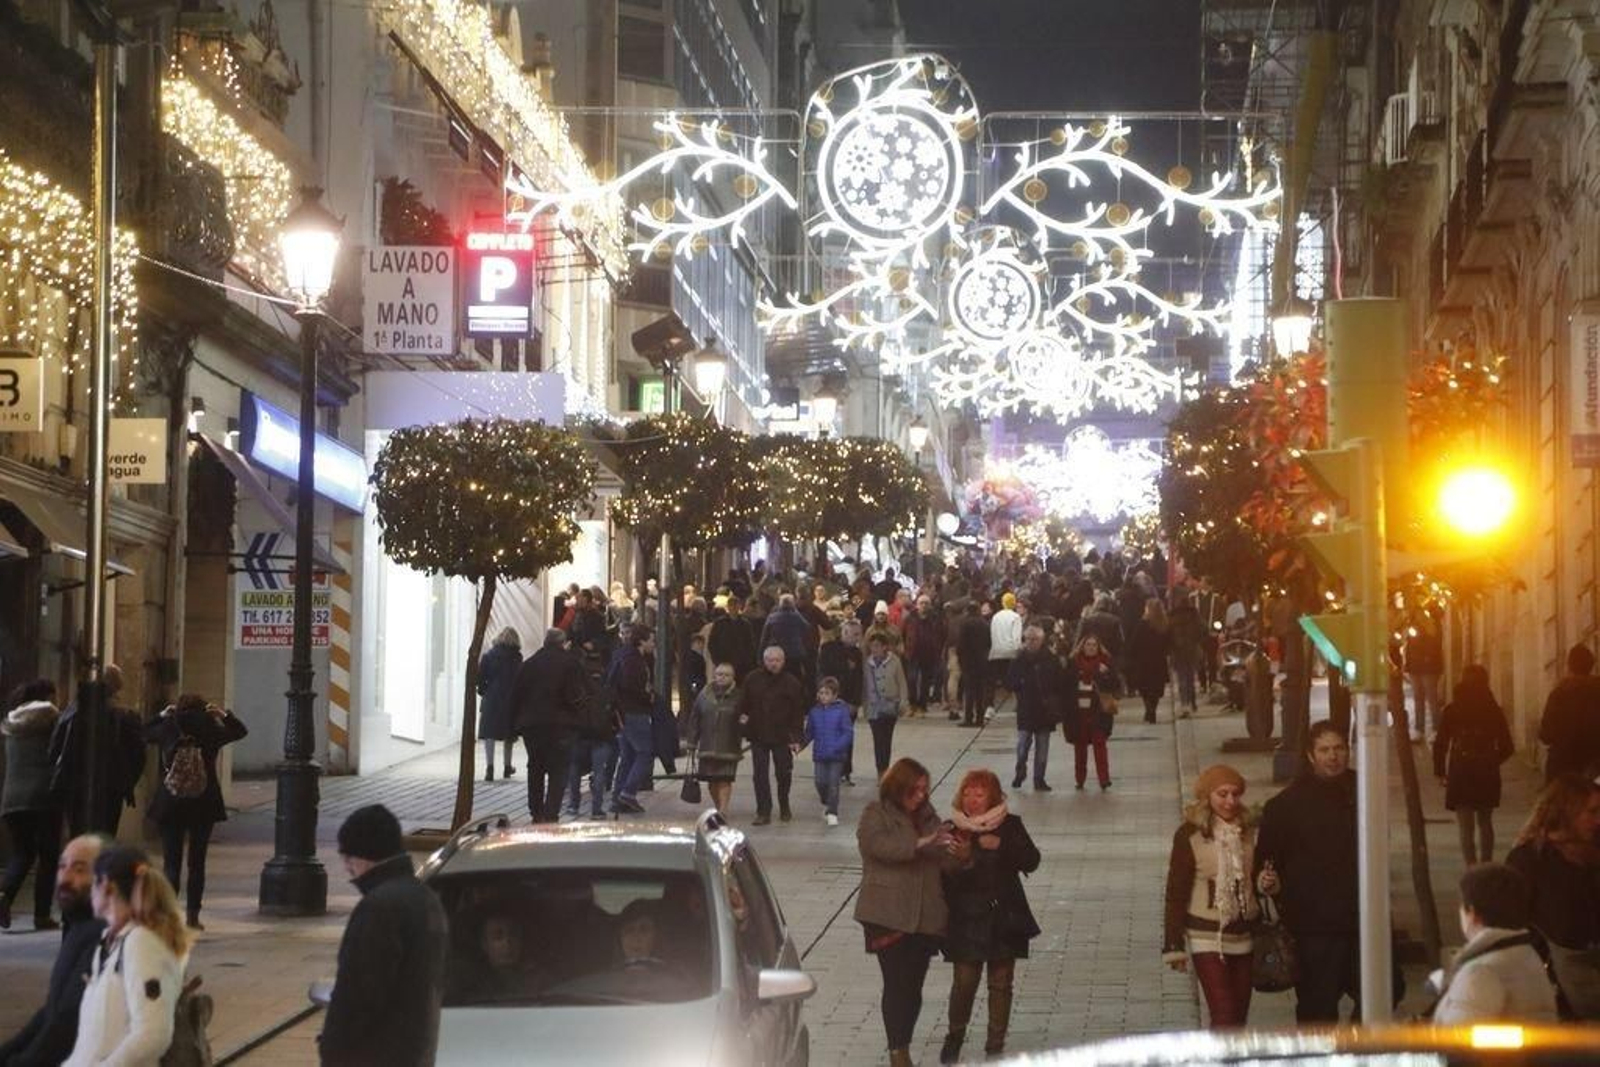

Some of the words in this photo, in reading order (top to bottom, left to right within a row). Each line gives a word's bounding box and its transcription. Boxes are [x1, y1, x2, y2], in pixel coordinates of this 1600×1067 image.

[369, 251, 449, 273] LAVADO
[480, 256, 518, 301] P
[402, 277, 415, 299] A
[377, 303, 438, 325] MANO
[393, 331, 443, 349] Planta
[243, 593, 284, 606] LAVADO
[262, 610, 282, 623] 617
[251, 626, 273, 635] UNA
[242, 636, 288, 645] PARKING
